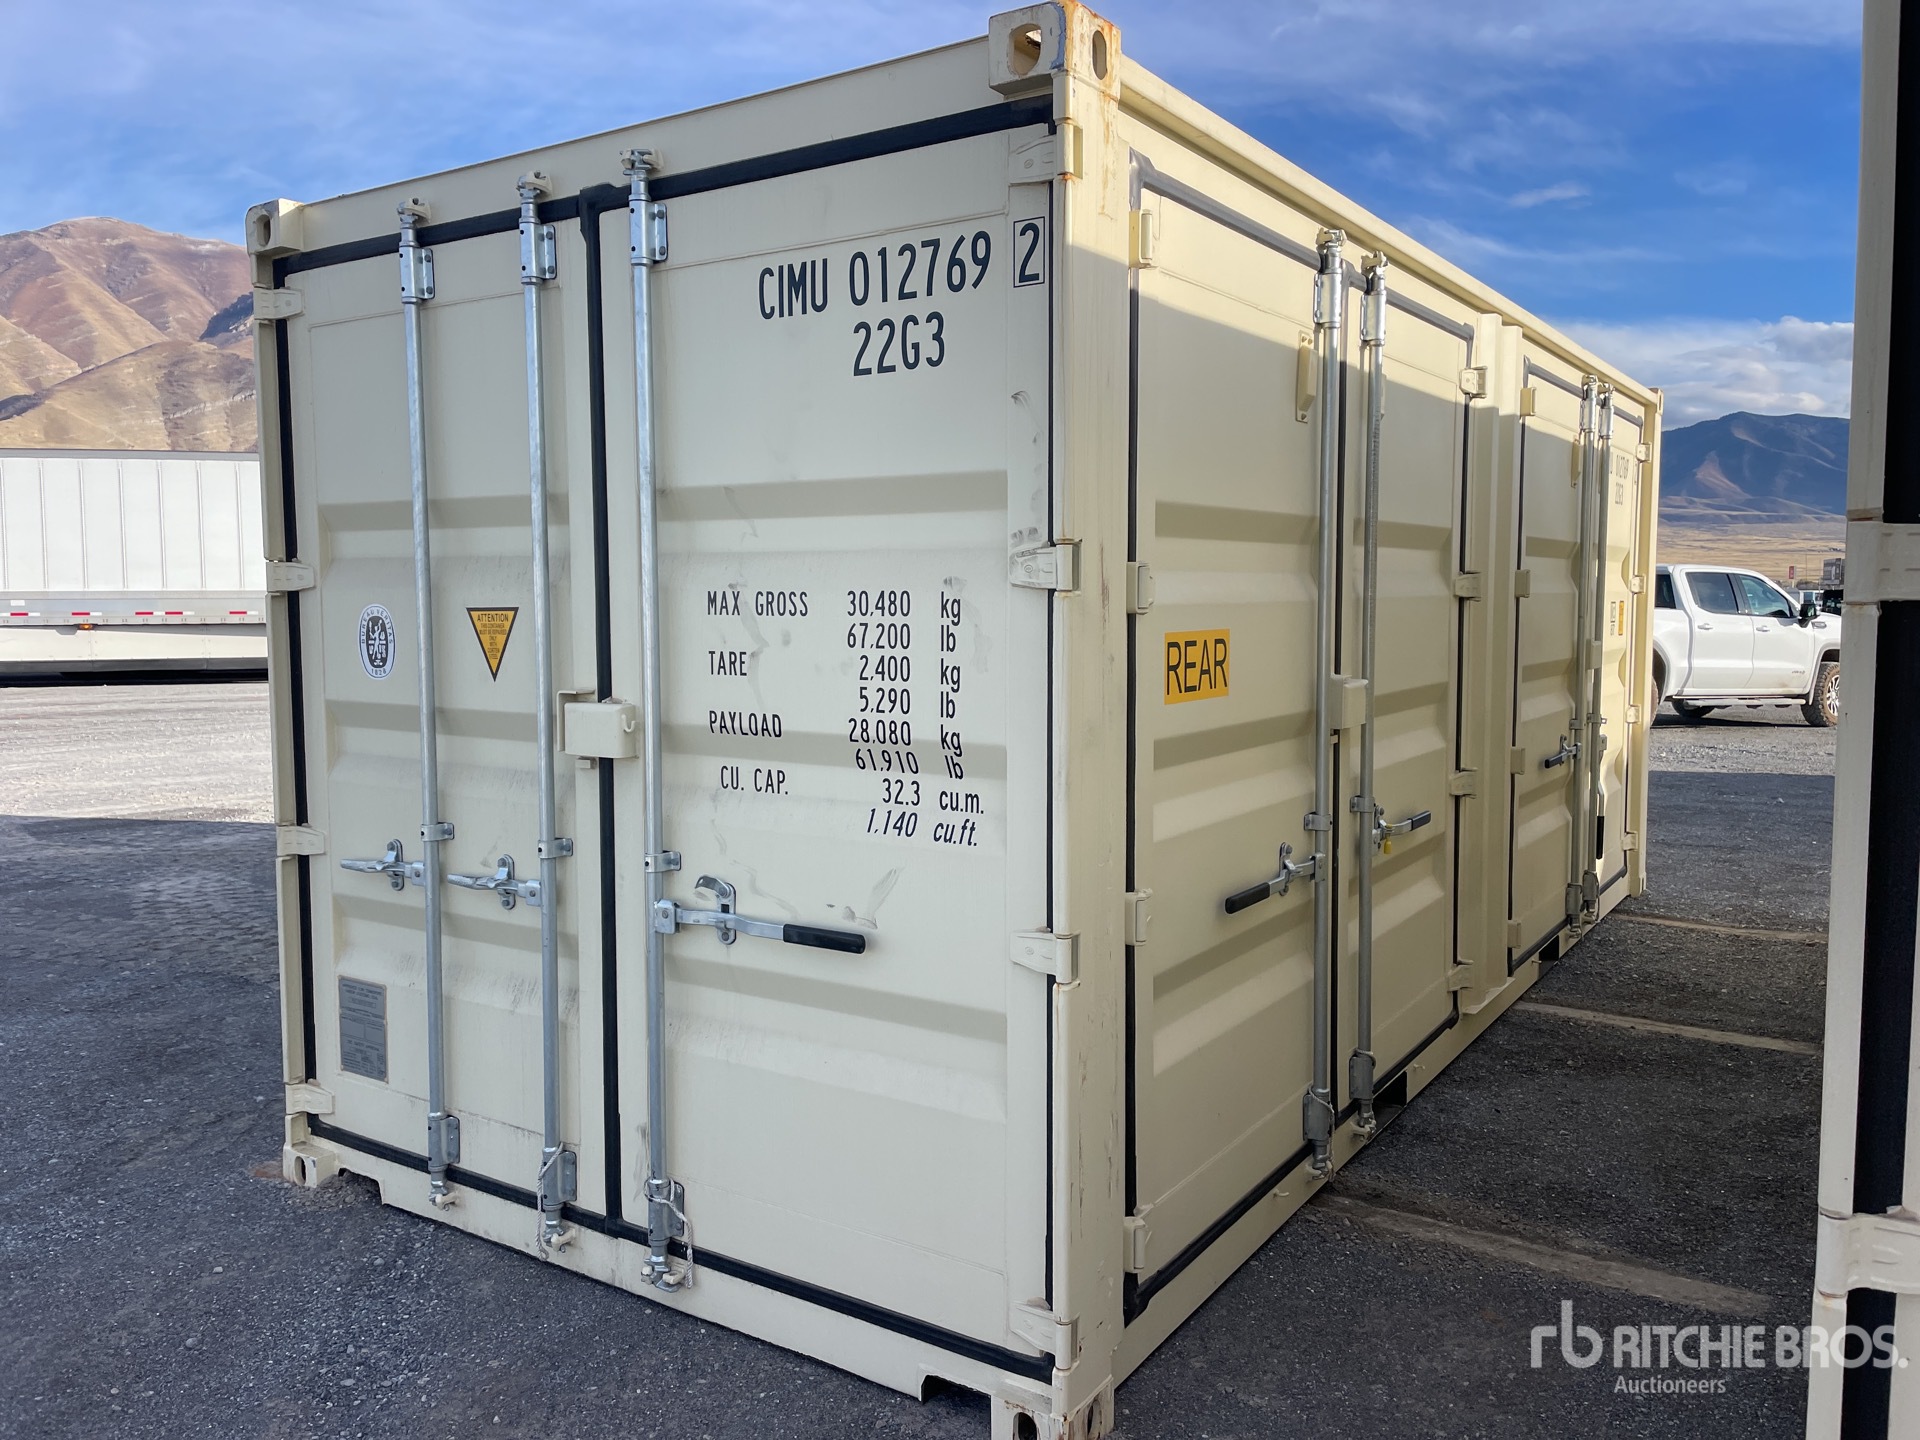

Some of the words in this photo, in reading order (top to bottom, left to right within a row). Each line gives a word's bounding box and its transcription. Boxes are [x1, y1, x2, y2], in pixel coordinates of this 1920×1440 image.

[758, 257, 828, 320] CIMU
[849, 230, 992, 306] 012769
[1018, 222, 1040, 283] 2
[853, 311, 945, 377] 22G3
[477, 613, 509, 622] ATTENTION
[707, 590, 741, 616] MAX
[755, 590, 809, 617] GROSS
[847, 590, 911, 617] 30,480
[940, 591, 961, 626] kg
[847, 622, 911, 650] 67,200
[940, 624, 957, 652] lb
[708, 650, 748, 677] TARE
[859, 654, 911, 682] 2,400
[940, 658, 961, 693] kg
[1167, 638, 1228, 696] REAR
[859, 686, 911, 715] 5,290
[940, 690, 956, 719] lb
[709, 710, 783, 738] PAYLOAD
[848, 717, 912, 747] 28,080
[940, 724, 963, 757] kg
[855, 748, 920, 775] 61,910
[944, 754, 964, 780] lb
[720, 765, 745, 792] CU.
[754, 768, 789, 795] CAP.
[882, 777, 921, 807] 32.3
[939, 789, 985, 815] cu.m.
[866, 807, 919, 838] 1,140
[933, 818, 978, 847] cu.ft.
